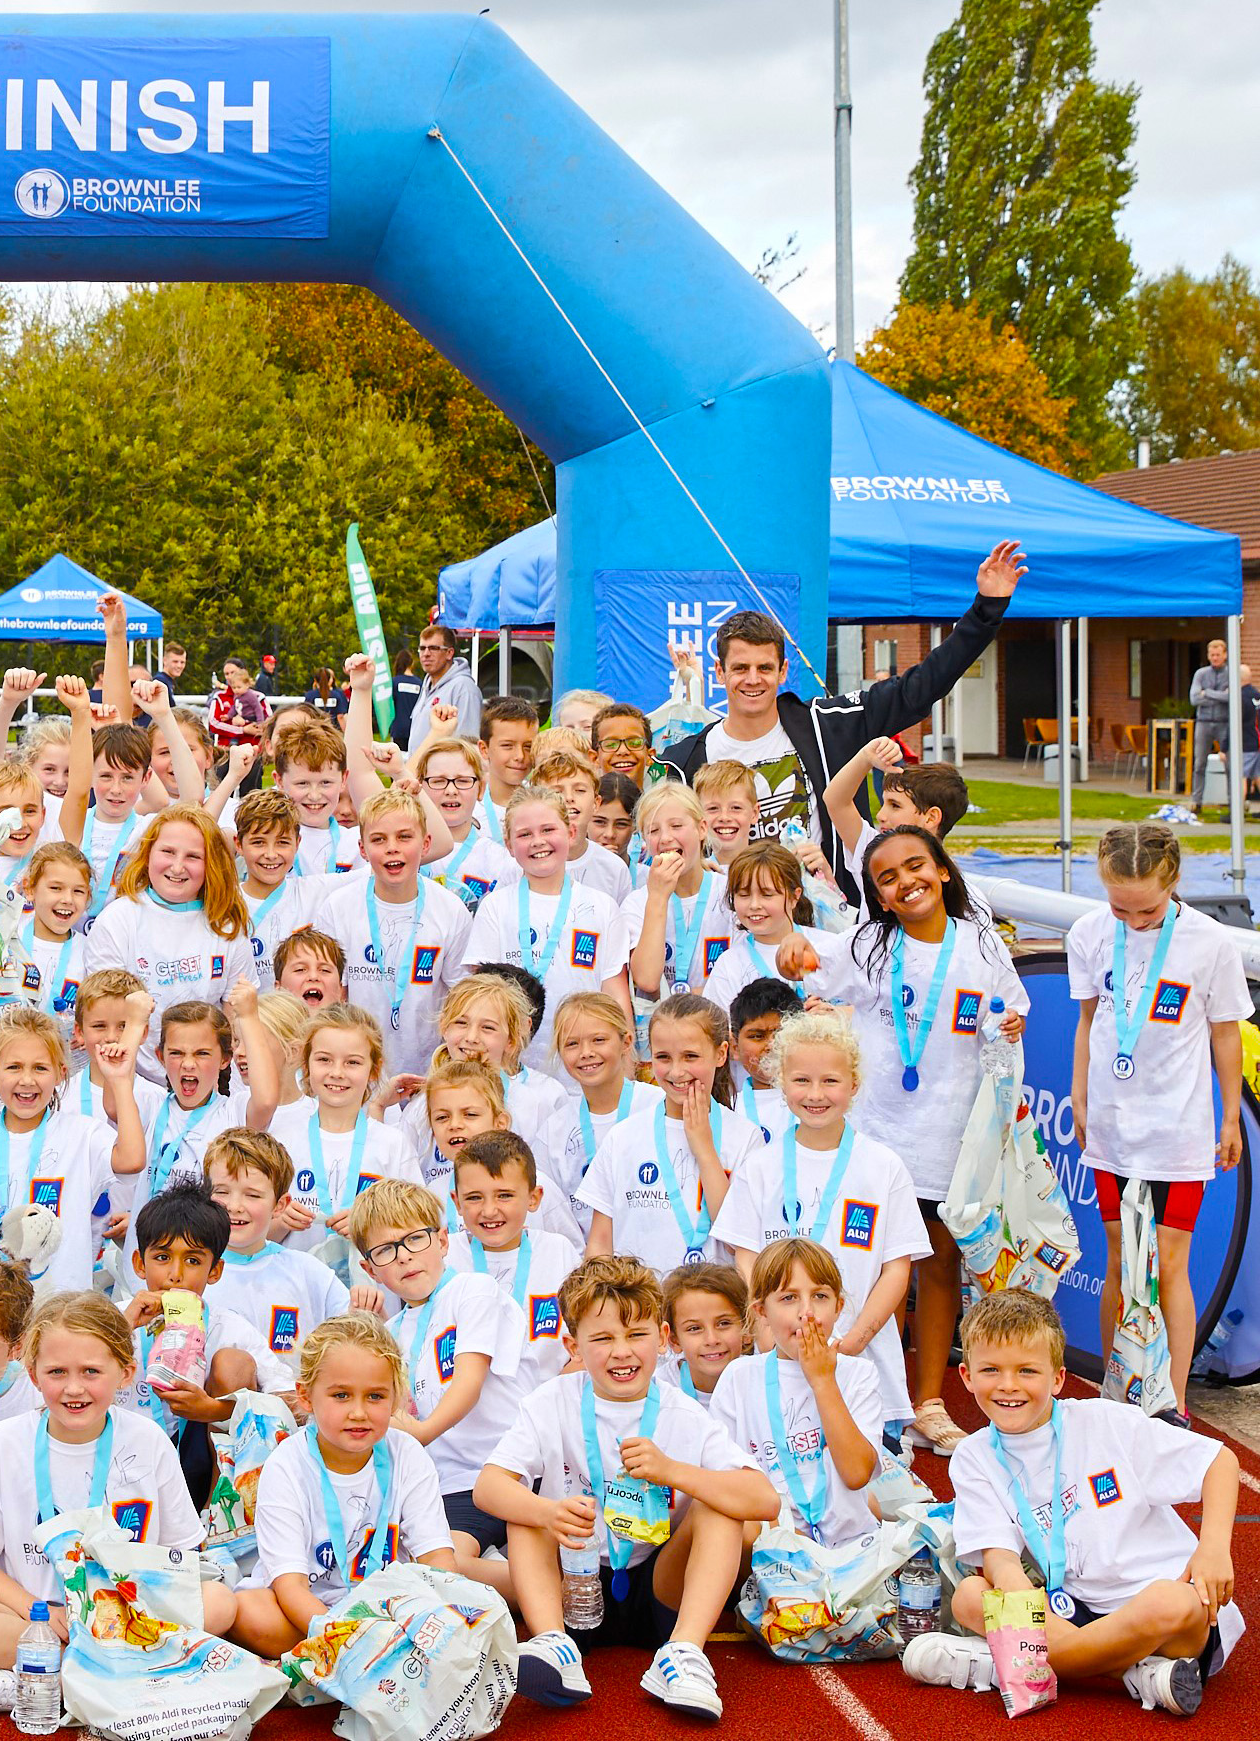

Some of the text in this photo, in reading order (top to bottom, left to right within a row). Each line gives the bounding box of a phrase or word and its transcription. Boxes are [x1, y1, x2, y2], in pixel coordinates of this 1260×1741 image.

[72, 177, 201, 197] BROWNLEE
[73, 196, 201, 213] FOUNDATION
[830, 476, 1005, 493] BROWNLEE
[835, 488, 1011, 504] FOUNDATION
[575, 951, 593, 962] ALDI
[156, 955, 201, 977] GETSET
[1156, 1004, 1179, 1016] ALDI
[846, 1228, 869, 1241] ALDI
[536, 1319, 557, 1332] ALDI
[1099, 1487, 1118, 1501] ALDI
[449, 1694, 465, 1715] you
[461, 1674, 480, 1697] shop
[114, 1719, 135, 1732] least
[137, 1713, 160, 1726] 80%
[161, 1707, 180, 1720] Aldi
[181, 1702, 221, 1717] Recycled
[445, 1704, 472, 1738] replace
[151, 1721, 191, 1739] recycled
[194, 1731, 210, 1740] our
